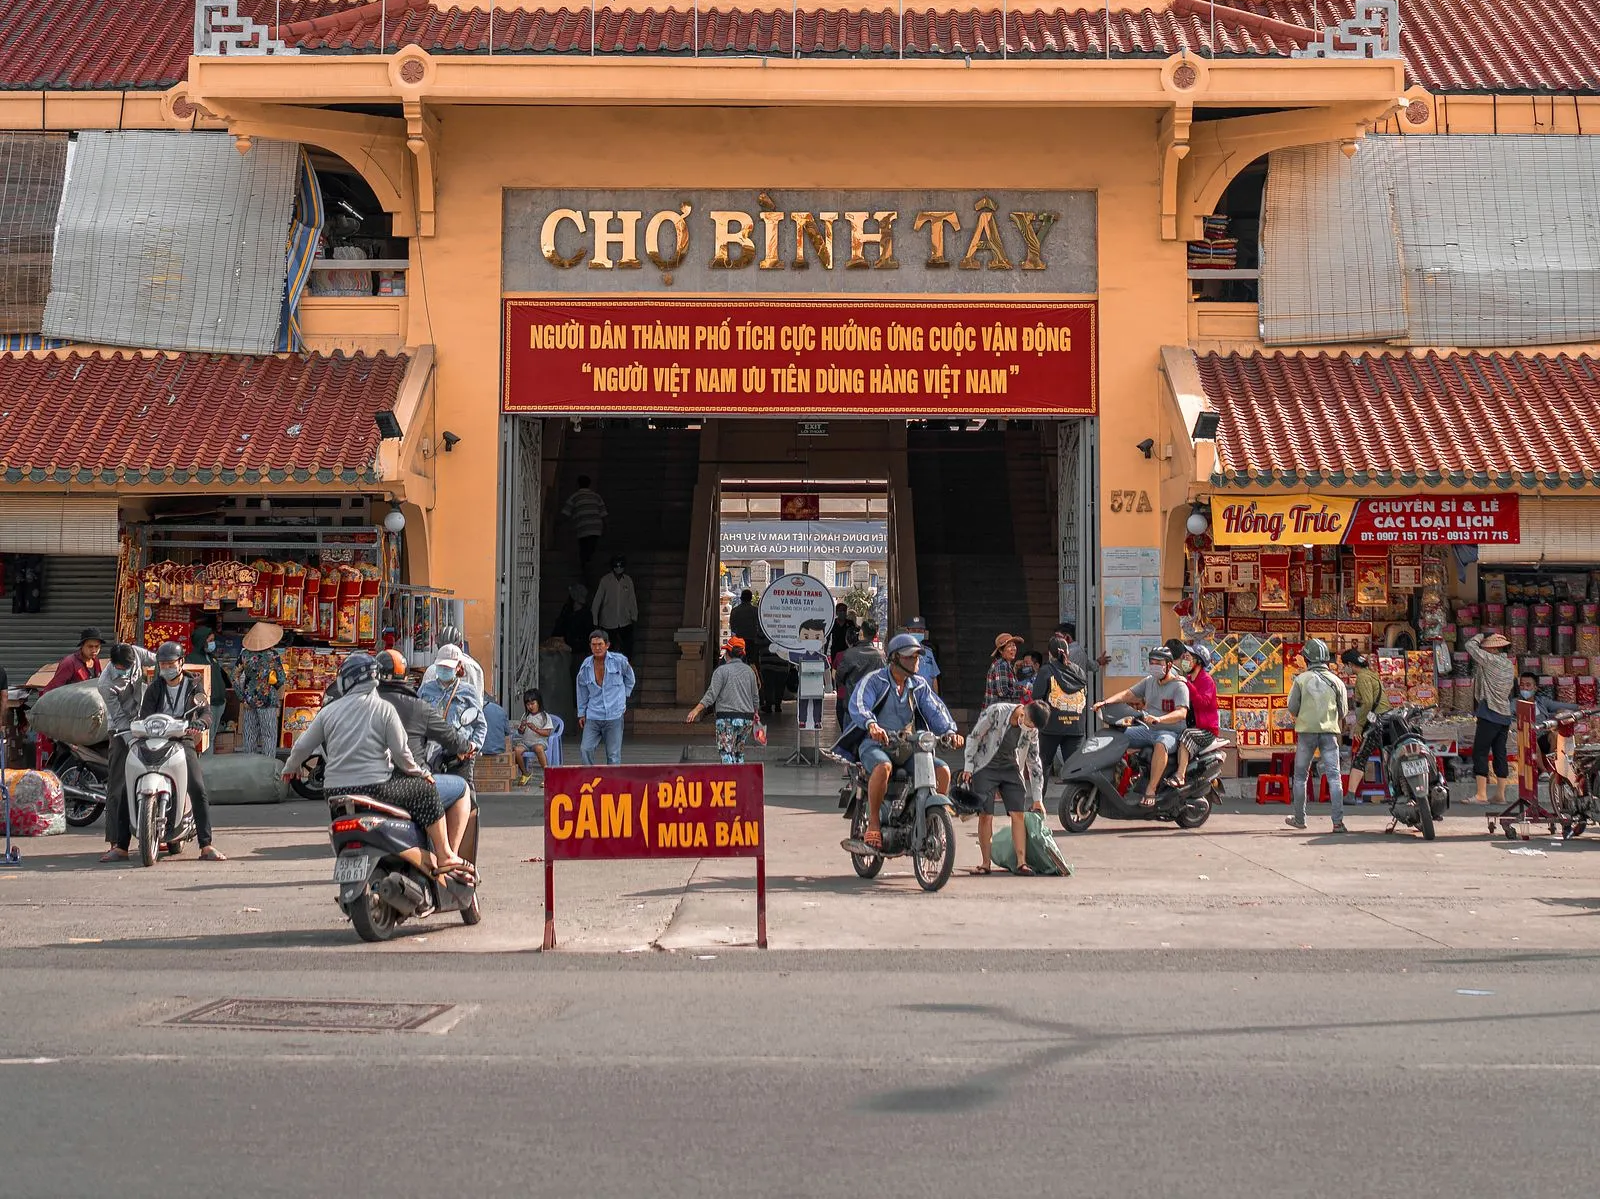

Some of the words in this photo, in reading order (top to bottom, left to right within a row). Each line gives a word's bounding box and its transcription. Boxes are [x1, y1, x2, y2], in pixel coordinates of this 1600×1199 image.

[540, 200, 692, 286] CHỢ
[710, 191, 899, 270] BÌNH
[913, 196, 1060, 270] TÂY
[530, 319, 584, 350] NGƯỜI
[590, 320, 627, 350] DÂN
[632, 320, 690, 350] THÀNH
[695, 317, 731, 350] PHỐ
[736, 321, 775, 351] TÍCH
[780, 325, 816, 356] CỰC
[821, 318, 882, 351] HƯỞNG
[887, 322, 924, 351] ỨNG
[930, 322, 976, 357] CUỘC
[981, 322, 1017, 357] VẬN
[1022, 322, 1071, 357] ĐỘNG
[653, 363, 690, 398] VIỆT
[695, 367, 736, 393] NAM
[742, 366, 766, 393] ƯU
[771, 363, 811, 393] TIÊN
[815, 364, 864, 394] DÙNG
[869, 364, 918, 394] HÀNG
[924, 364, 960, 399] VIỆT
[1110, 489, 1153, 513] 57A
[1368, 499, 1436, 513] CHUYÊN
[1462, 500, 1477, 513] &
[1222, 501, 1286, 542] Hồng
[1289, 504, 1342, 533] Trúc
[1374, 514, 1406, 528] CÁC
[1411, 516, 1450, 530] LOẠI
[1457, 516, 1495, 530] LỊCH
[1377, 531, 1399, 541] 0907
[1402, 531, 1418, 541] 151
[1421, 531, 1439, 541] 715
[1447, 531, 1470, 541] 0913
[1473, 531, 1488, 540] 171
[1491, 531, 1509, 540] 715
[803, 590, 823, 598] TRANG
[550, 777, 632, 840] CẤM
[657, 775, 703, 814] ĐẬU
[709, 780, 737, 808] XE
[658, 820, 709, 848] MUA
[715, 815, 760, 847] BÁN
